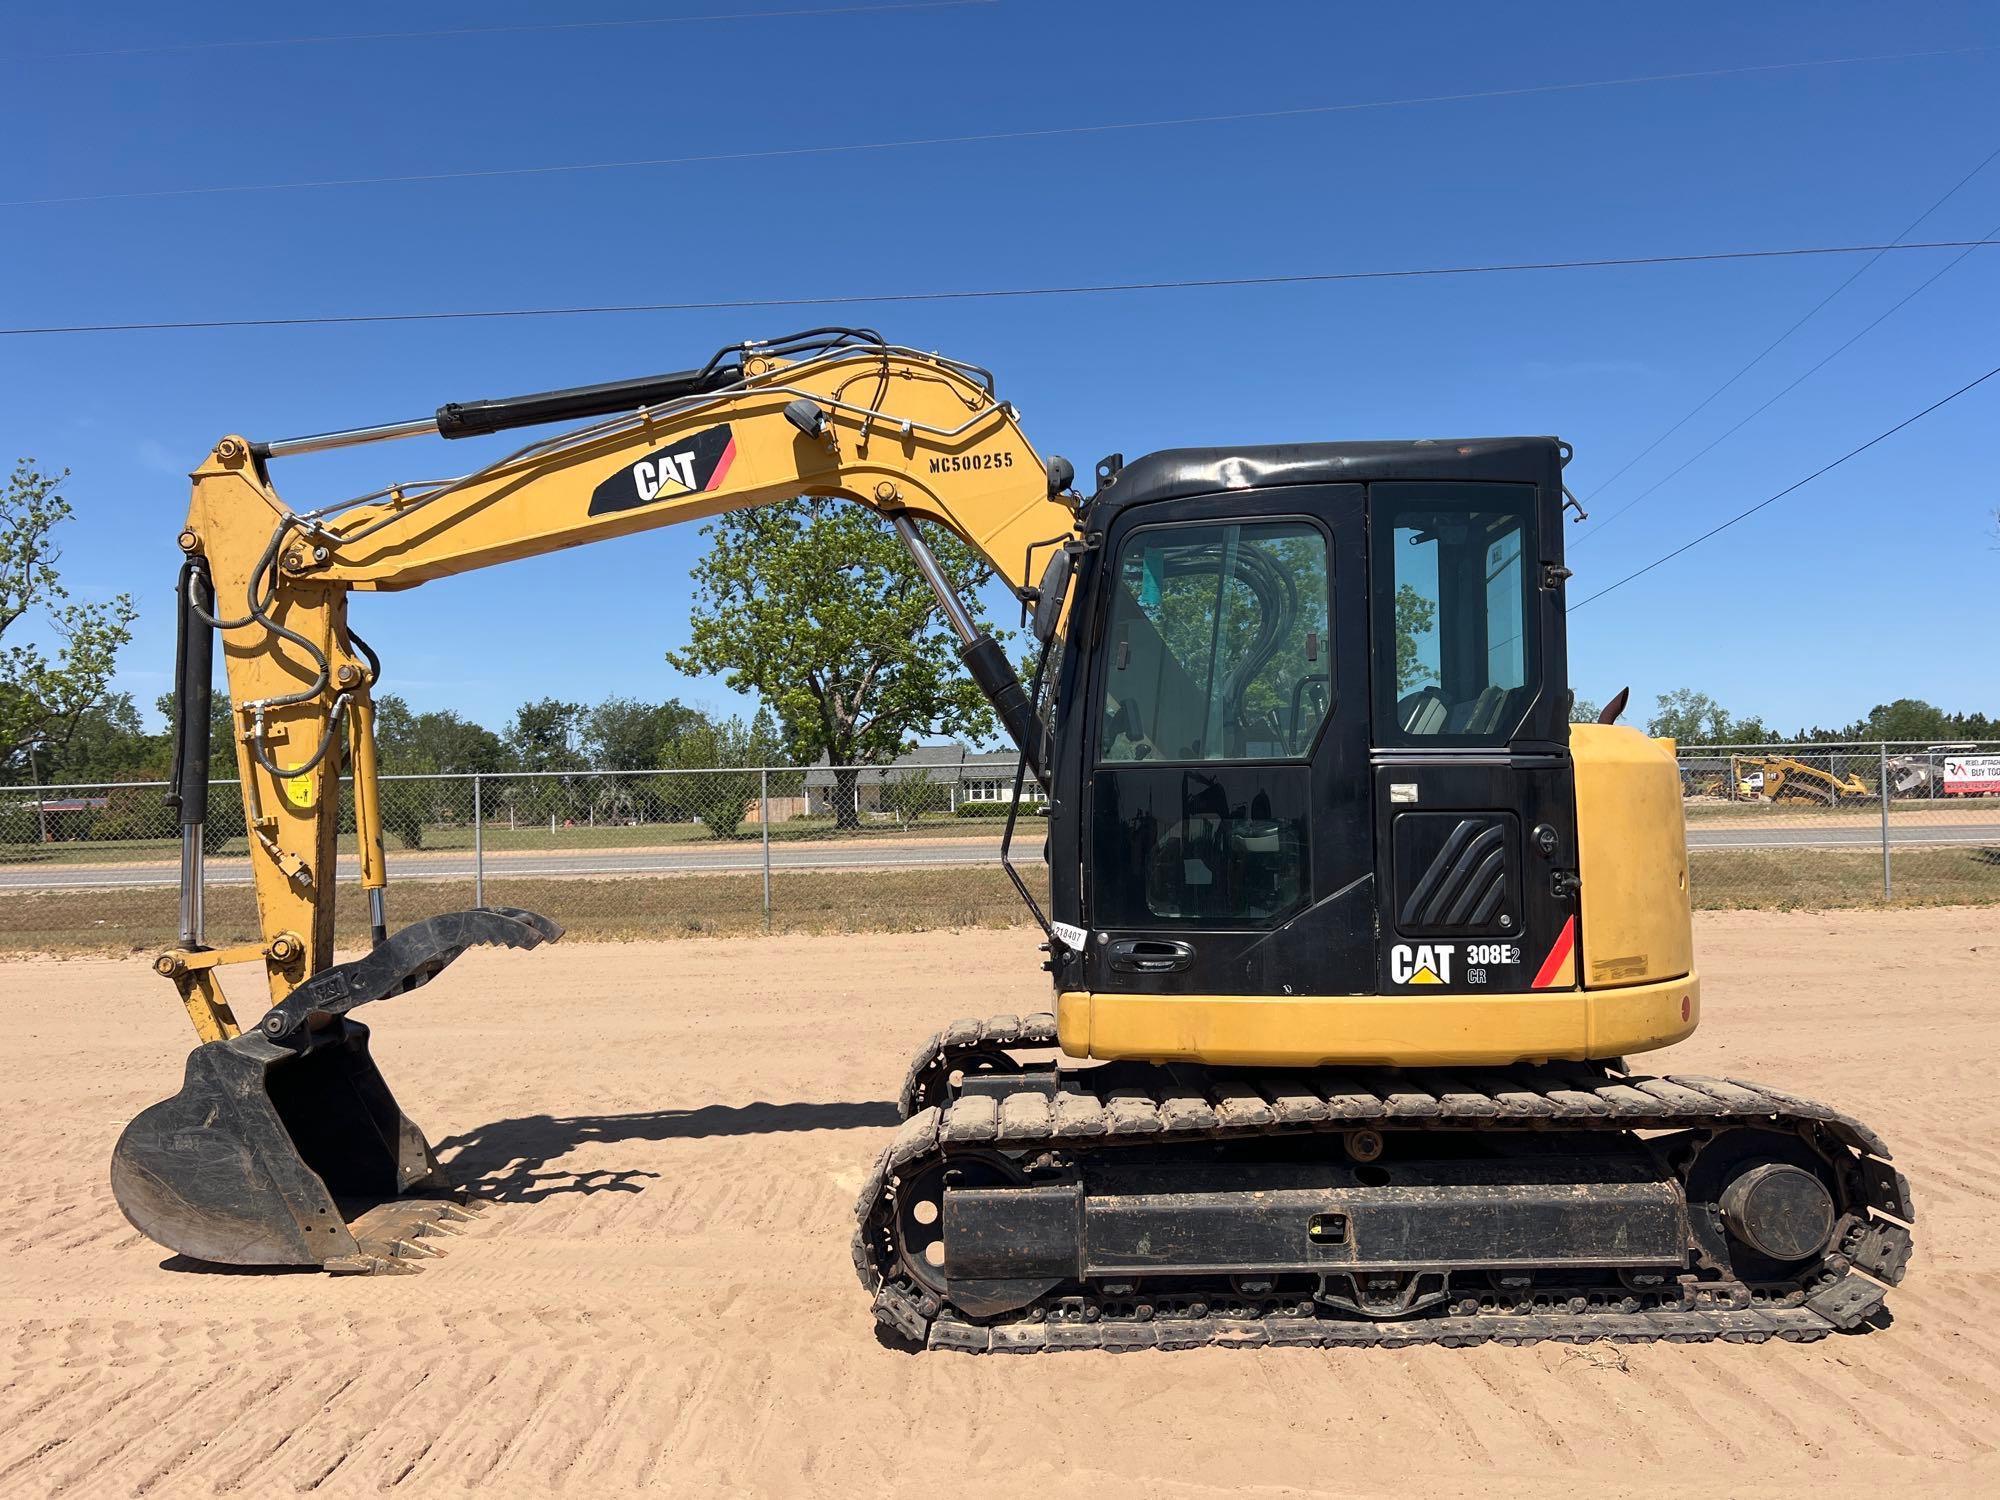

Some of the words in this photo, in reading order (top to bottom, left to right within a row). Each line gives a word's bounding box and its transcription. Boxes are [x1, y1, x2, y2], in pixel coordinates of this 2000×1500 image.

[929, 452, 1013, 474] MC500255
[633, 450, 697, 501] CAT
[1971, 768, 1985, 776] BUY
[1055, 926, 1082, 942] 218407
[1391, 944, 1455, 984] CAT
[1467, 968, 1487, 983] CR
